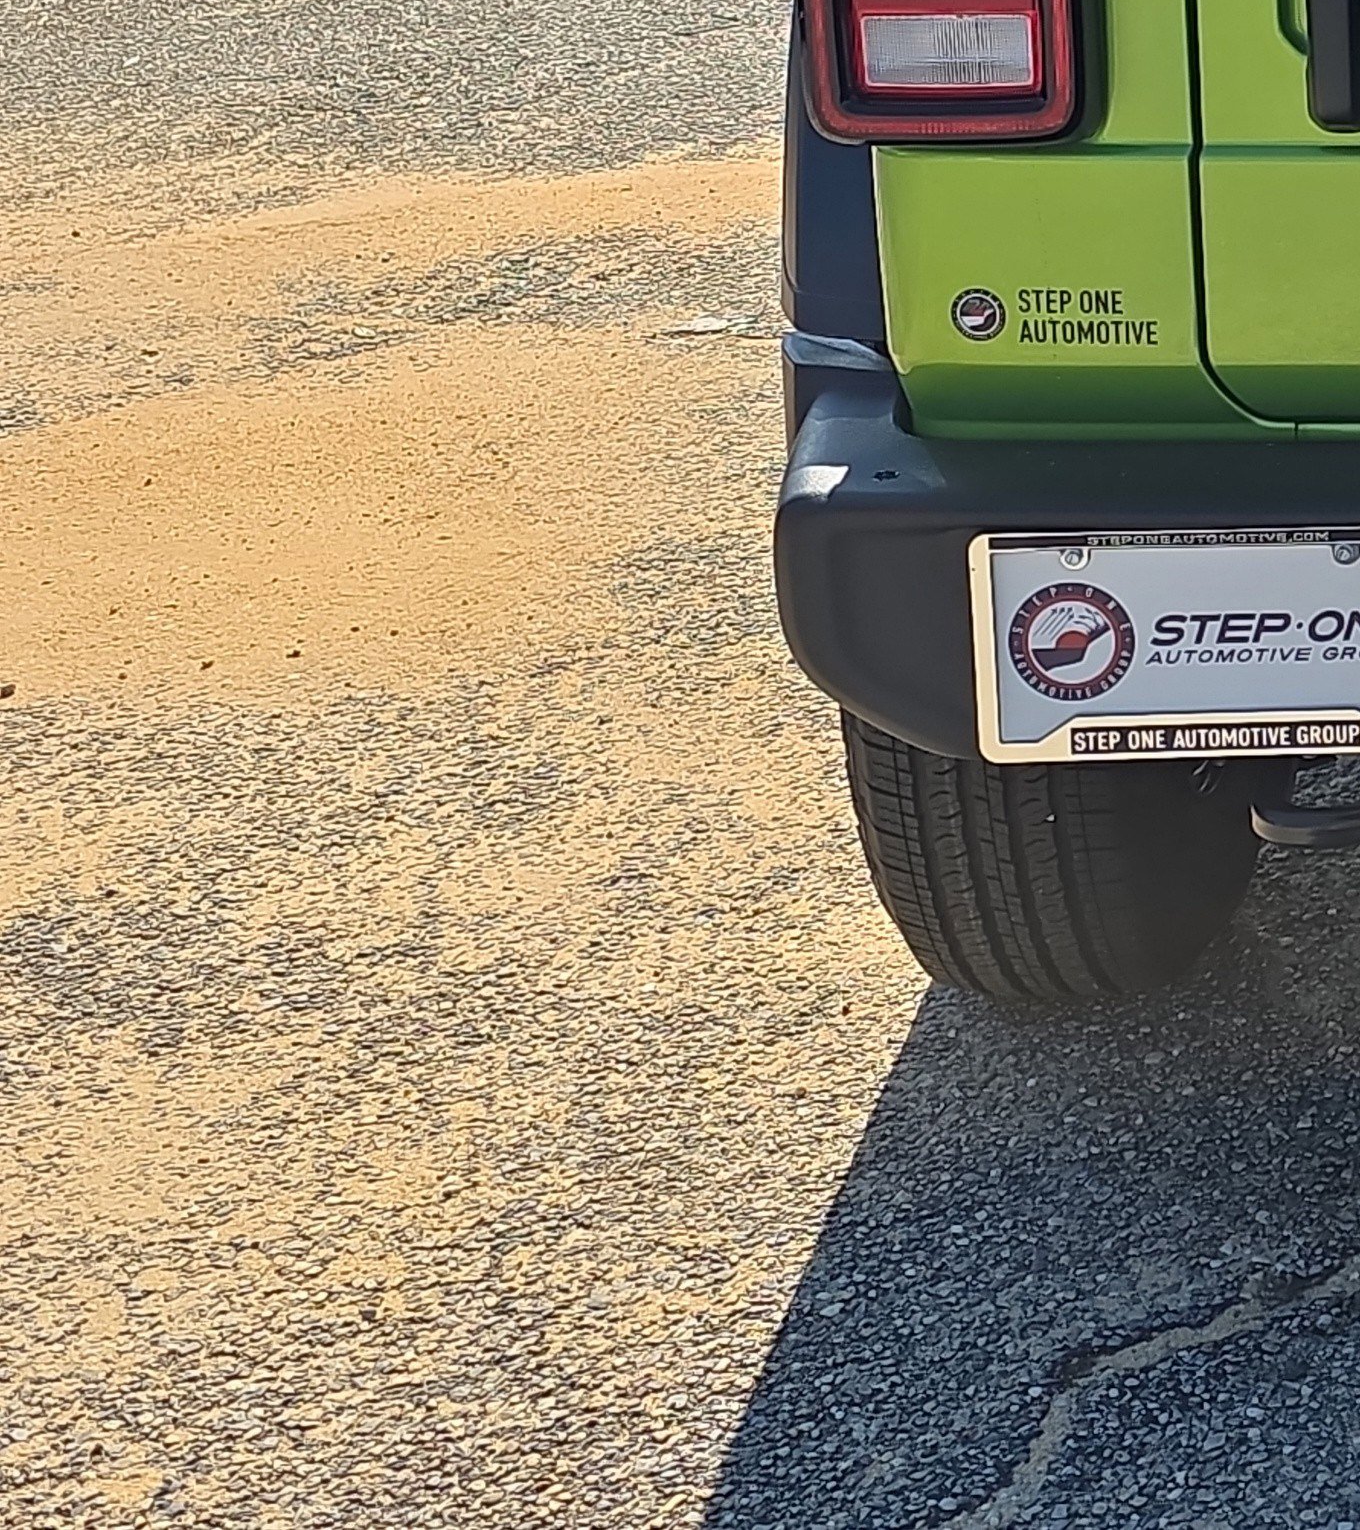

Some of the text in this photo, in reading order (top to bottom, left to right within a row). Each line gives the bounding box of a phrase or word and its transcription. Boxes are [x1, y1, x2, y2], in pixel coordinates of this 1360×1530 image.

[1018, 290, 1123, 314] STEP ONE
[1020, 320, 1158, 345] AUTOMOTIVE
[1087, 531, 1329, 547] STEPONEAUTOMOTIVE.COM
[1146, 646, 1311, 665] AUTOMOTIVE
[1074, 724, 1360, 752] STEP ONE AUTOMOTIVE GROUP
